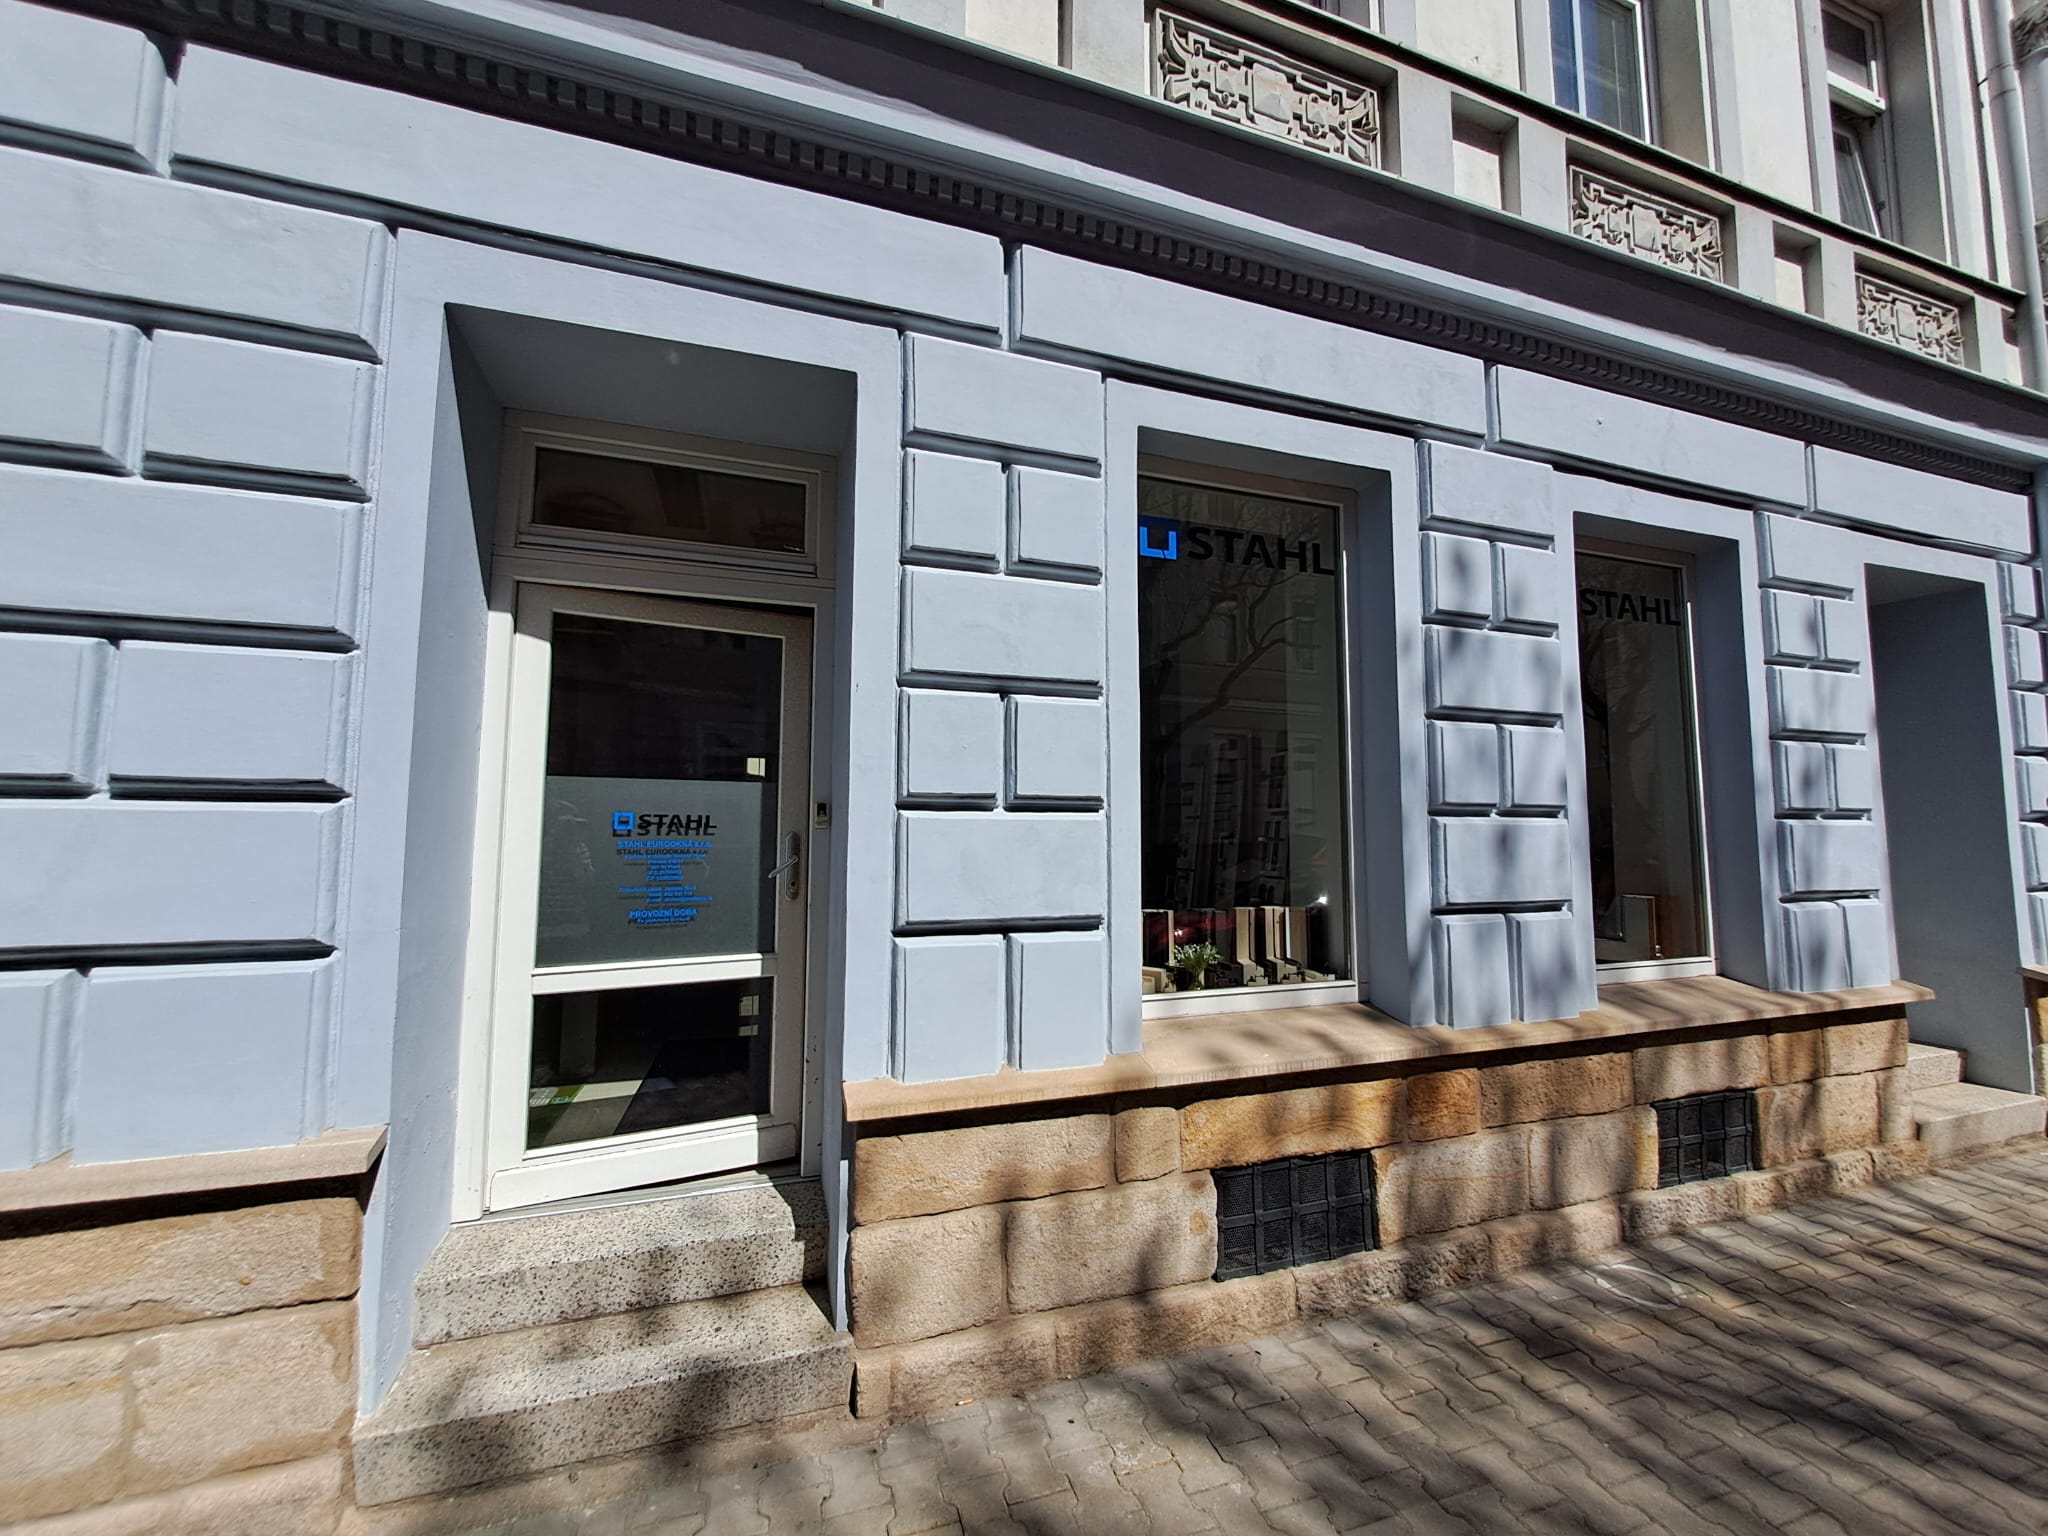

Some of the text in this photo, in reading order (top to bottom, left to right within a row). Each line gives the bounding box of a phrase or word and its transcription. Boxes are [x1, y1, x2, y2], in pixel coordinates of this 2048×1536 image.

[1187, 526, 1335, 576] STAHL
[1579, 588, 1681, 626] STAHL
[638, 814, 717, 829] STAHL
[617, 840, 645, 848] STAHL
